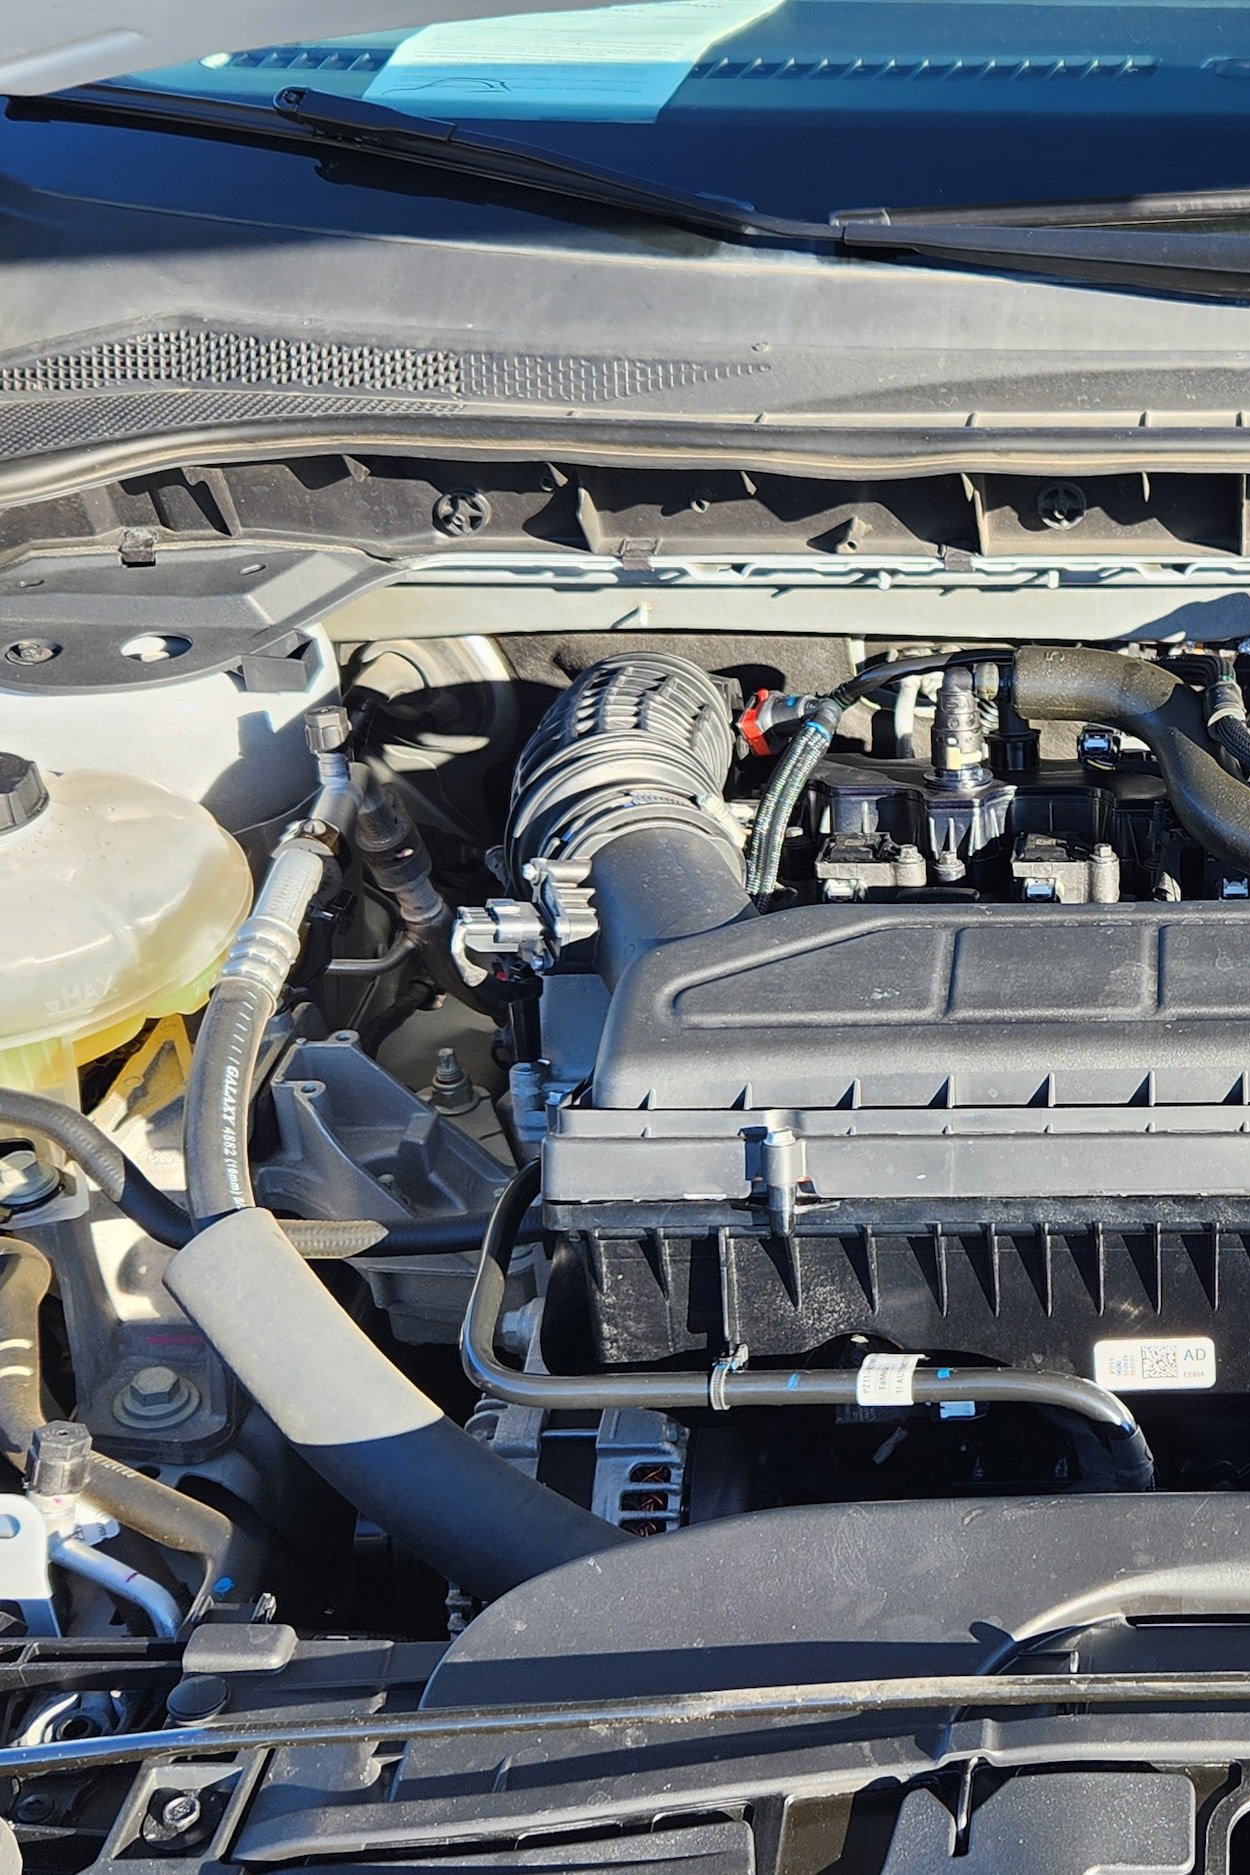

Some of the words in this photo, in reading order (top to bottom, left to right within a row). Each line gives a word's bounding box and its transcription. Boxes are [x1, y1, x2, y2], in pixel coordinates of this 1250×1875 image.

[222, 1065, 239, 1126] GALAXY
[222, 1126, 237, 1157] 4882
[1184, 1348, 1207, 1361] AD
